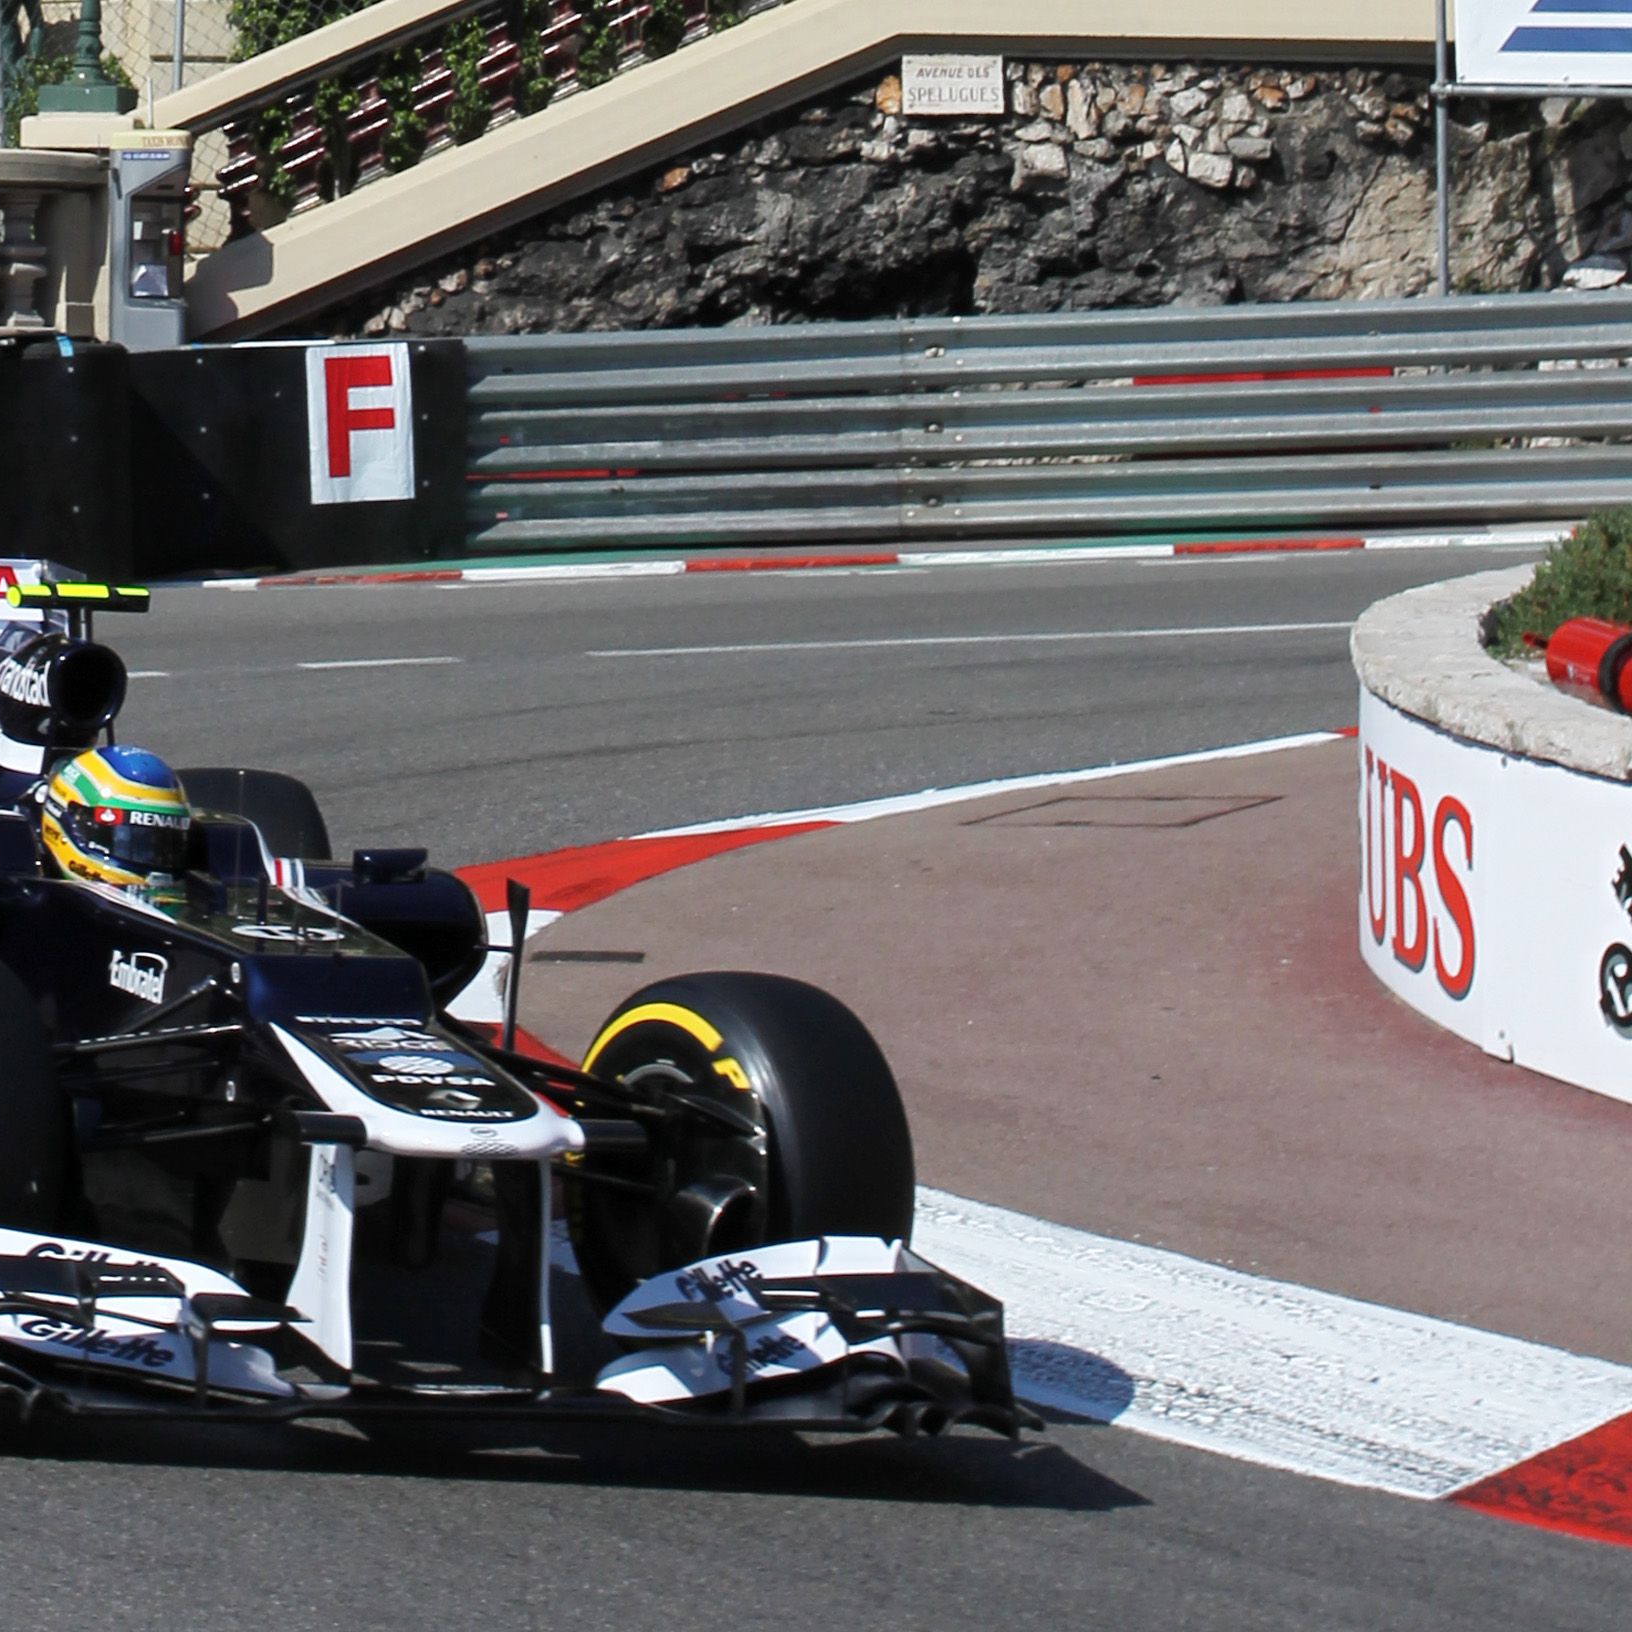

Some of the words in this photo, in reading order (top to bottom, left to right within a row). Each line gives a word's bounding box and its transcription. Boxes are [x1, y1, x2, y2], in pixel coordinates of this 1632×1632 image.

[916, 67, 963, 78] AVENUE
[908, 87, 1000, 102] SPELUGUES
[324, 355, 395, 478] F
[1366, 744, 1475, 1002] UBS
[371, 1074, 496, 1086] PDVSA
[20, 1319, 175, 1367] Gillette
